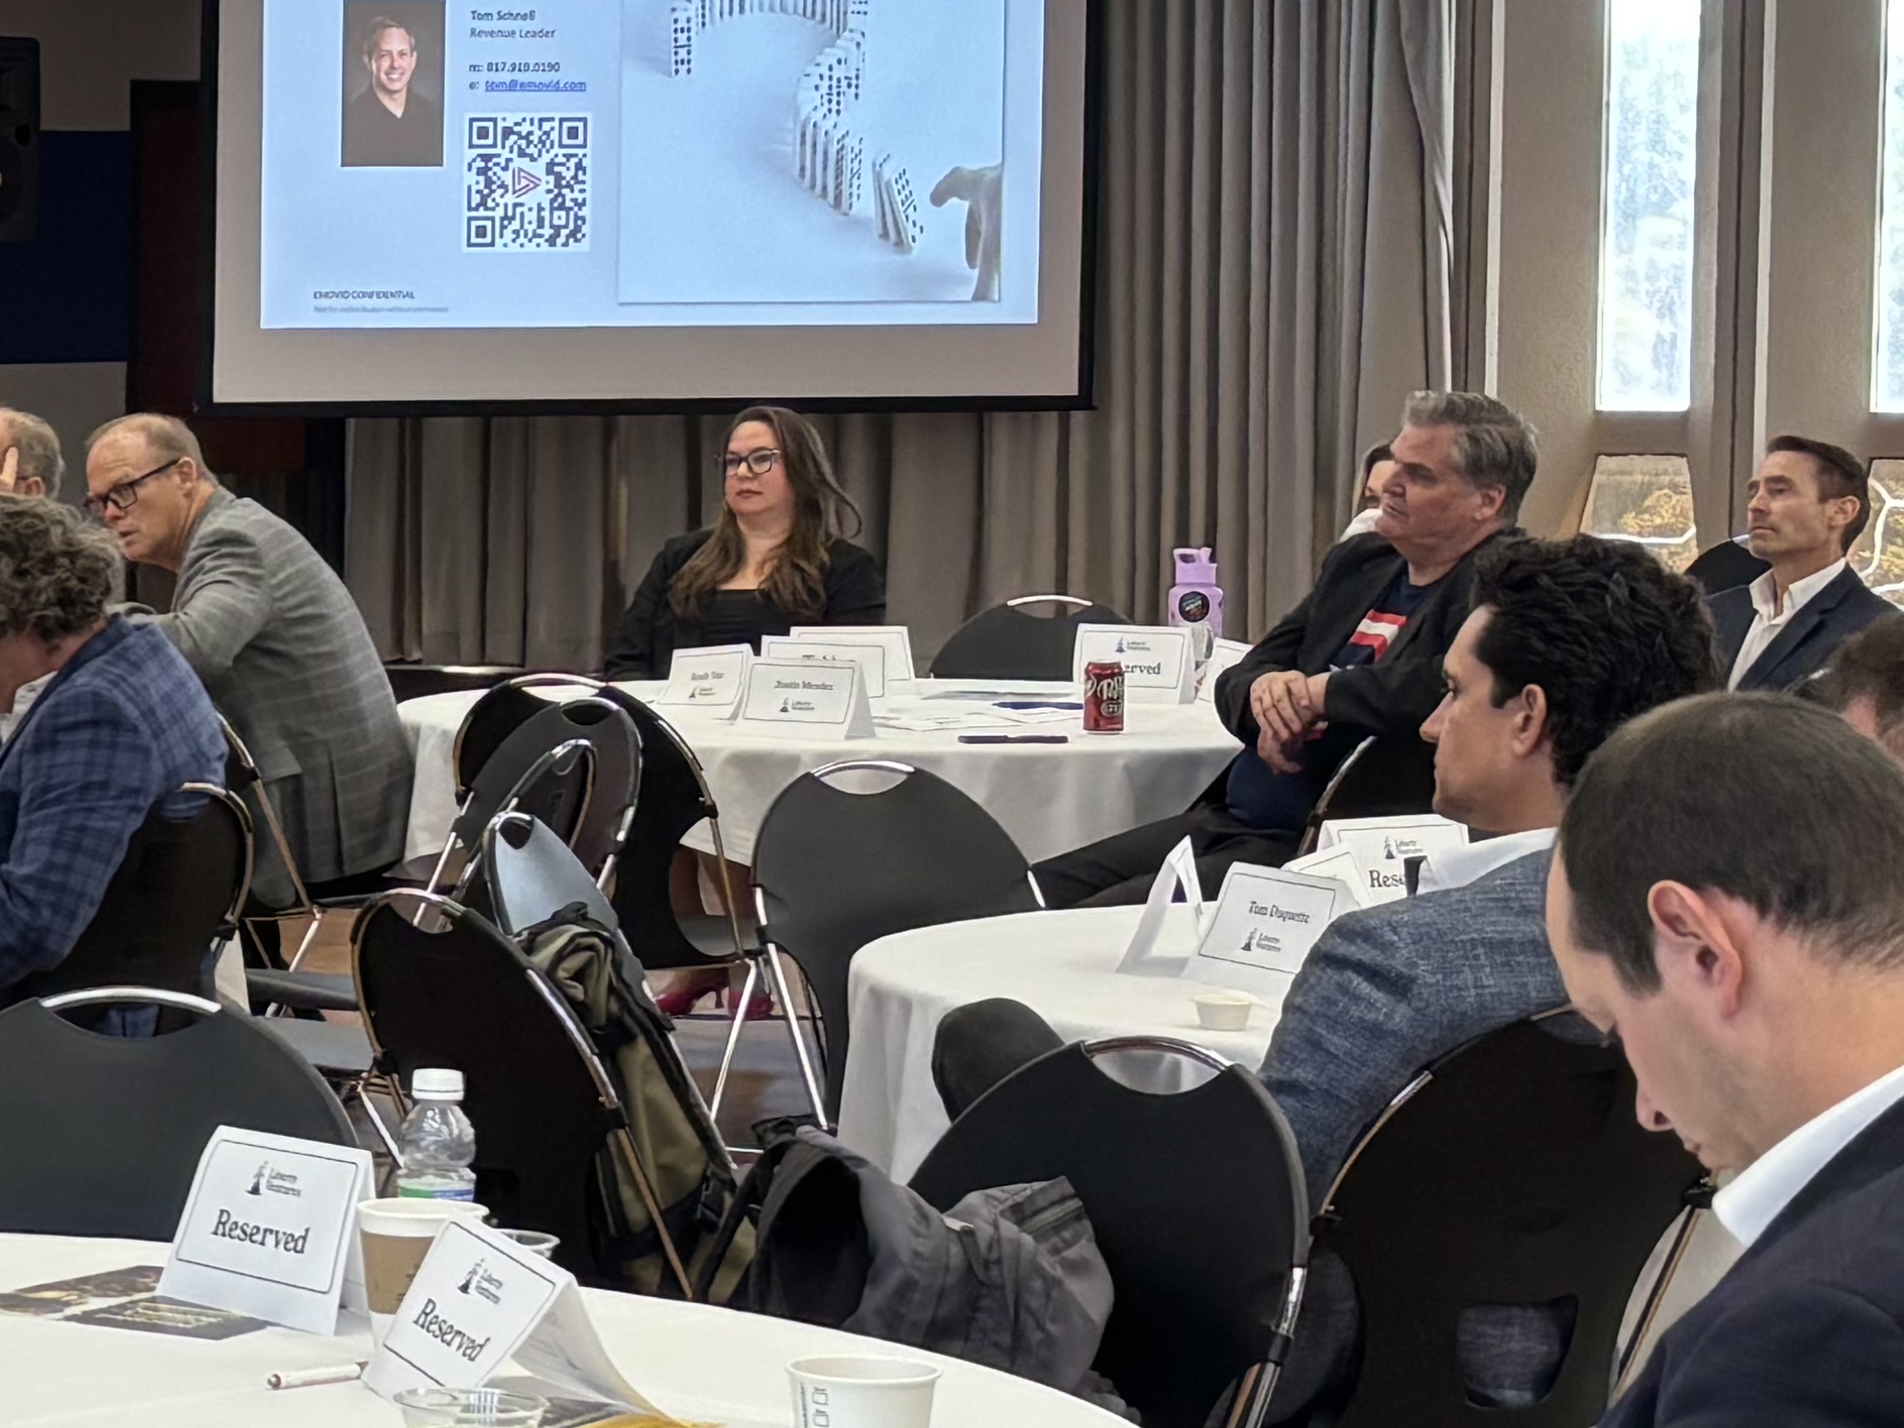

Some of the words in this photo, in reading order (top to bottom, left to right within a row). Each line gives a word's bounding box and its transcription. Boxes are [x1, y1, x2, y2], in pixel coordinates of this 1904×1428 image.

[470, 28, 516, 39] Revenue
[519, 28, 556, 39] Leader
[211, 1208, 311, 1255] Reserved
[412, 1297, 492, 1363] Reserved
